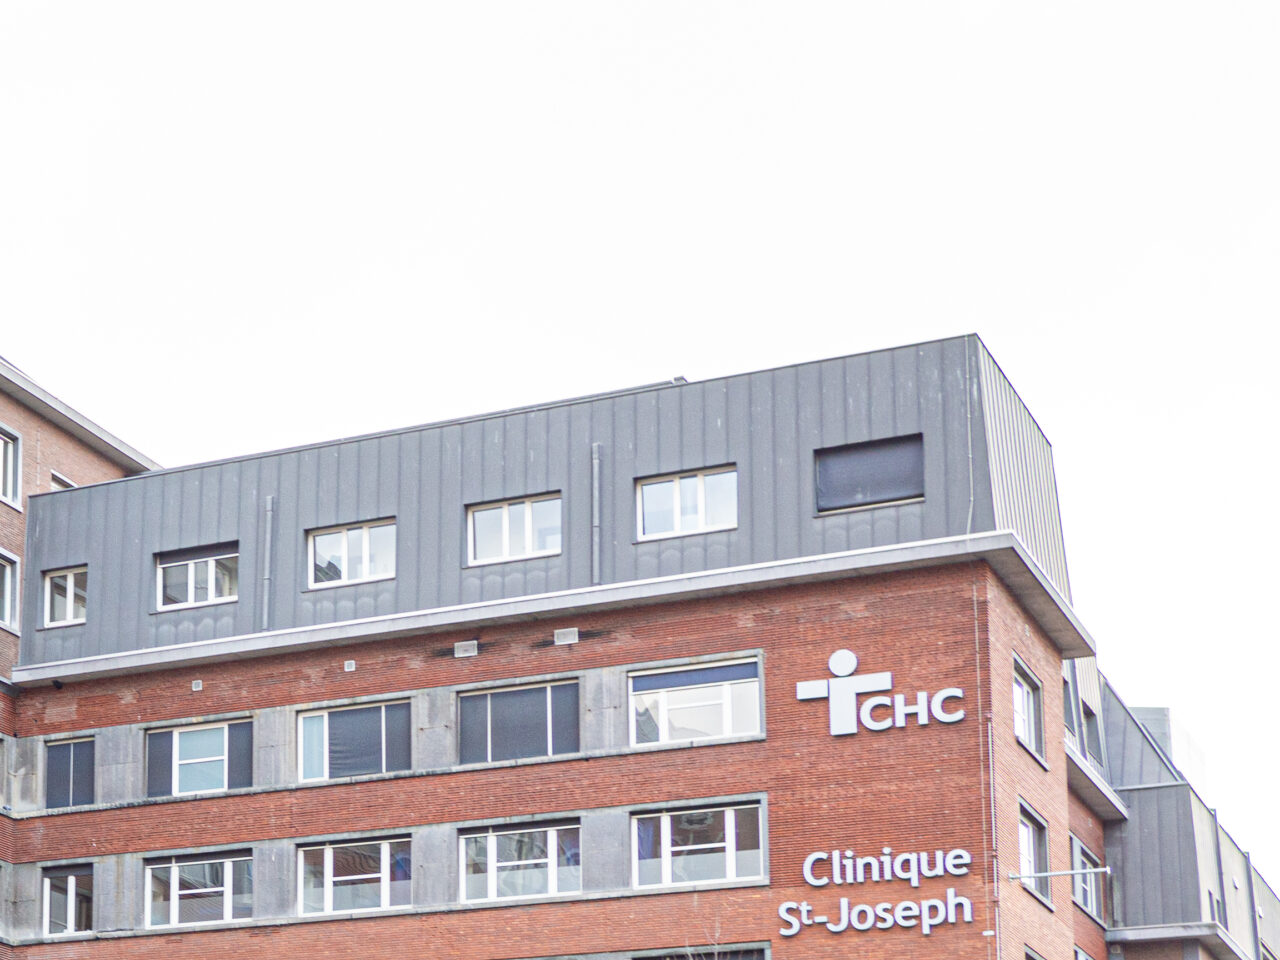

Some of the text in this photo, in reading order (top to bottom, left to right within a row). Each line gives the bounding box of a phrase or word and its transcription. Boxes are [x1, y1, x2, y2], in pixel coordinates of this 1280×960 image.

[859, 687, 966, 731] CHC
[802, 846, 972, 888] Clinique
[777, 887, 973, 937] St-Joseph
